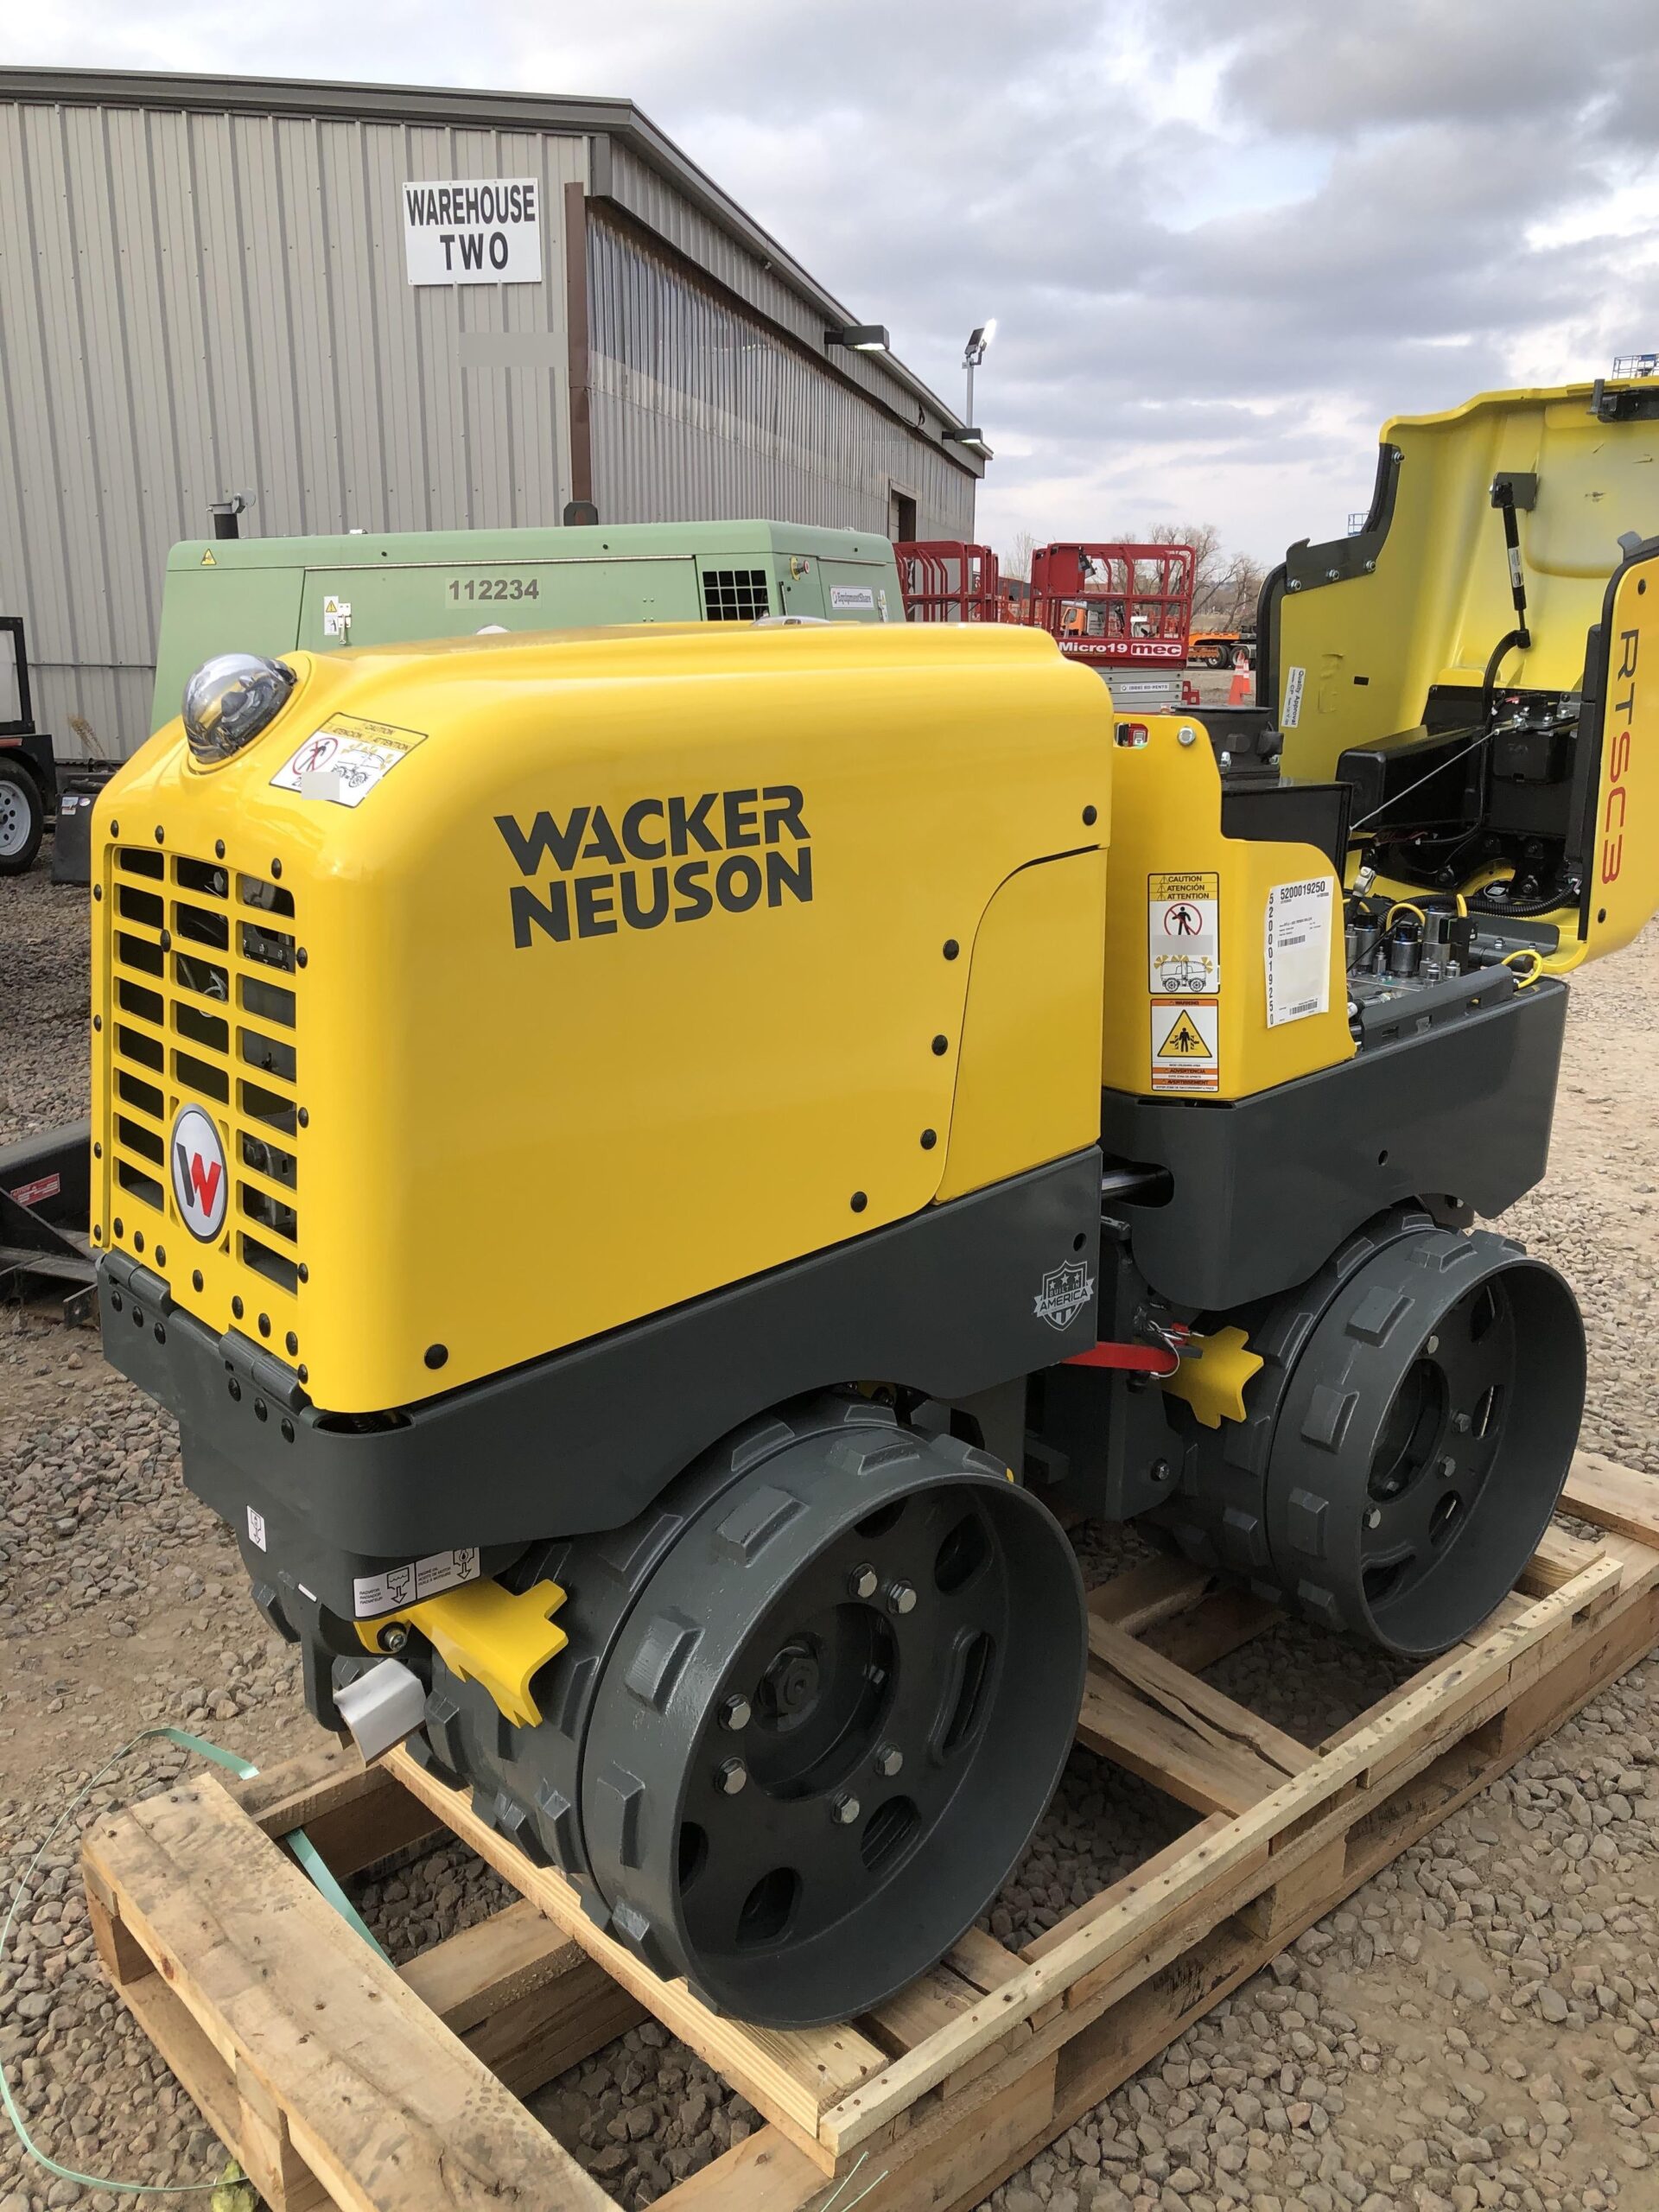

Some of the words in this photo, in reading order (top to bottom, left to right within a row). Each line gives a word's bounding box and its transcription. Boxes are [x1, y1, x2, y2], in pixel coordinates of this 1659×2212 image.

[406, 185, 536, 226] WAREHOUSE
[440, 232, 508, 270] TWO
[448, 579, 539, 601] 112234
[1058, 642, 1128, 654] Micro19
[1131, 644, 1182, 657] mec
[1294, 671, 1305, 694] Quality
[1291, 695, 1300, 726] Approval
[365, 724, 395, 735] CAUTION
[372, 737, 410, 751] ATTENTION
[493, 785, 811, 876] WACKER
[510, 847, 813, 949] NEUSON
[1281, 880, 1325, 900] 5200019250
[1039, 1287, 1089, 1313] AMERICA
[1049, 1285, 1070, 1297] BUILT
